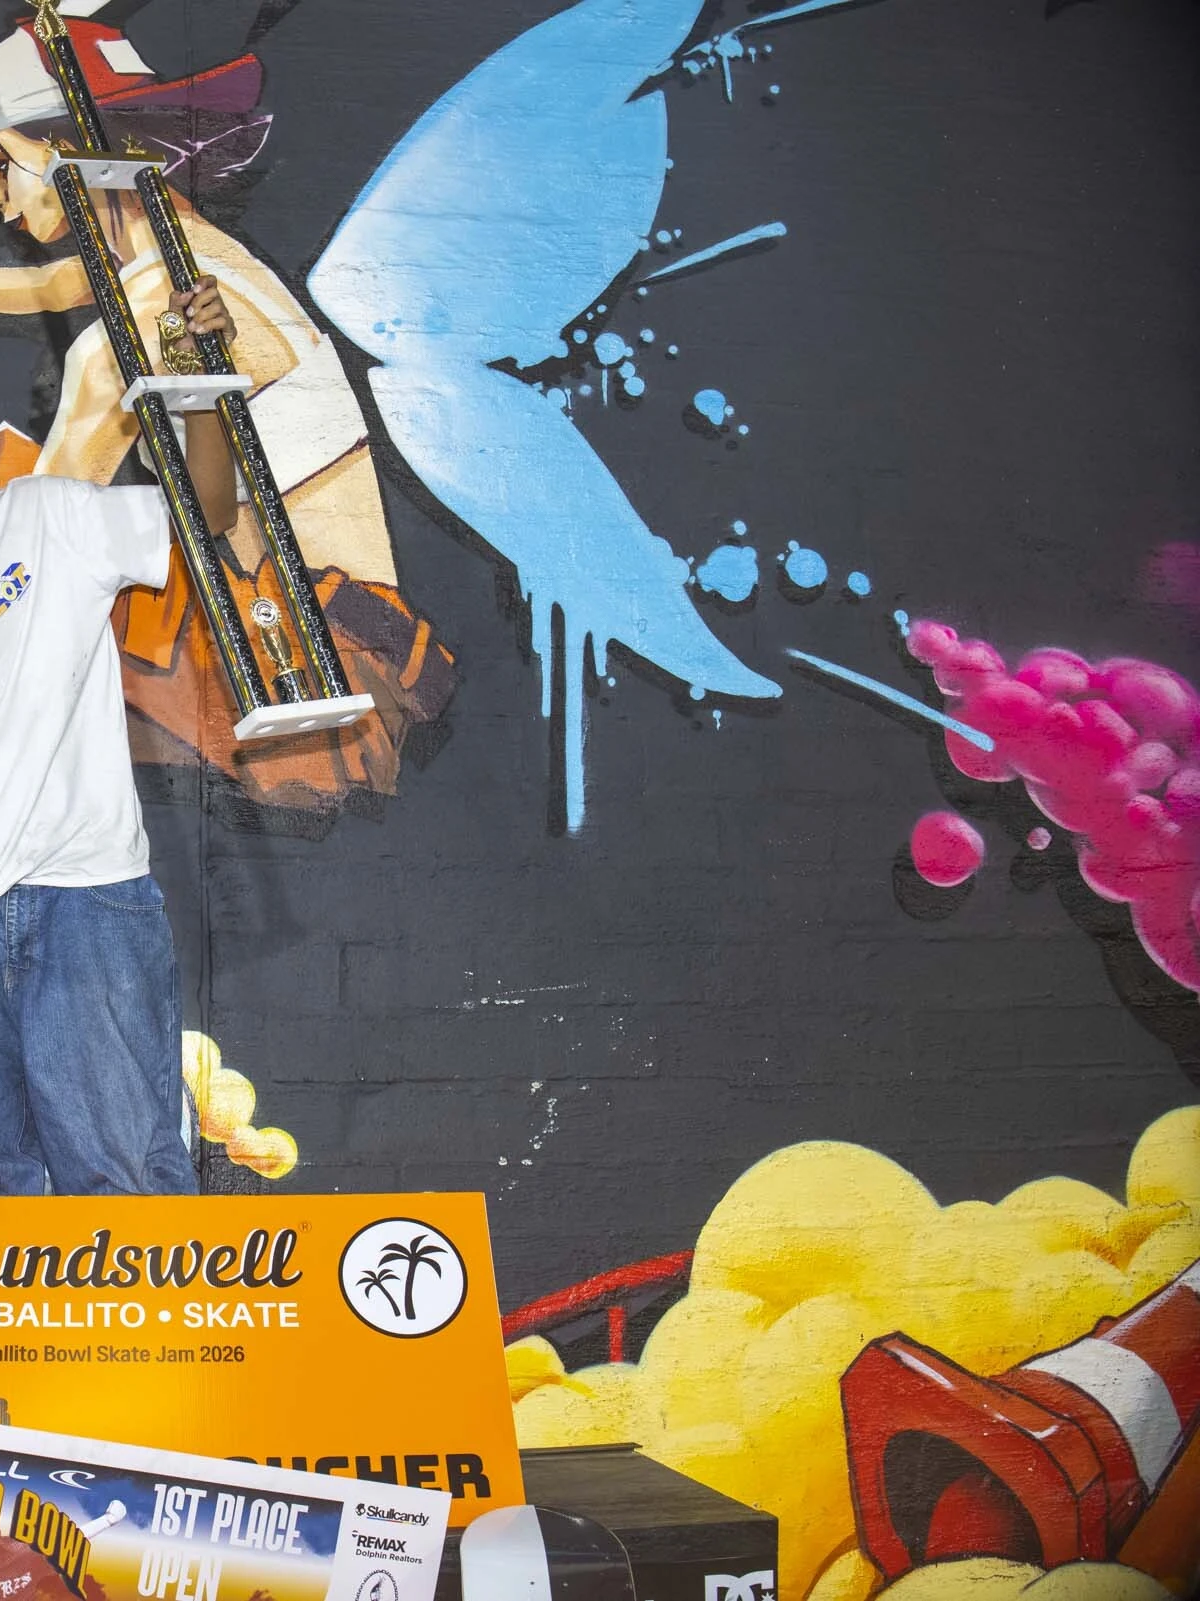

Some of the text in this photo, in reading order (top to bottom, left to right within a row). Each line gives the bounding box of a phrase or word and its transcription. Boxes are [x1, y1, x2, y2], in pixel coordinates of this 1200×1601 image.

[183, 1302, 300, 1328] SKATE
[44, 1345, 91, 1363] Bowl
[97, 1345, 150, 1363] Skate
[156, 1345, 194, 1363] Jam
[200, 1345, 245, 1363] 2026
[151, 1483, 309, 1555] 1ST PLACE
[366, 1506, 429, 1526] Skullcandy
[10, 1488, 92, 1601] BOWL
[356, 1549, 423, 1564] Dolphin Realtors
[137, 1549, 223, 1601] OPEN
